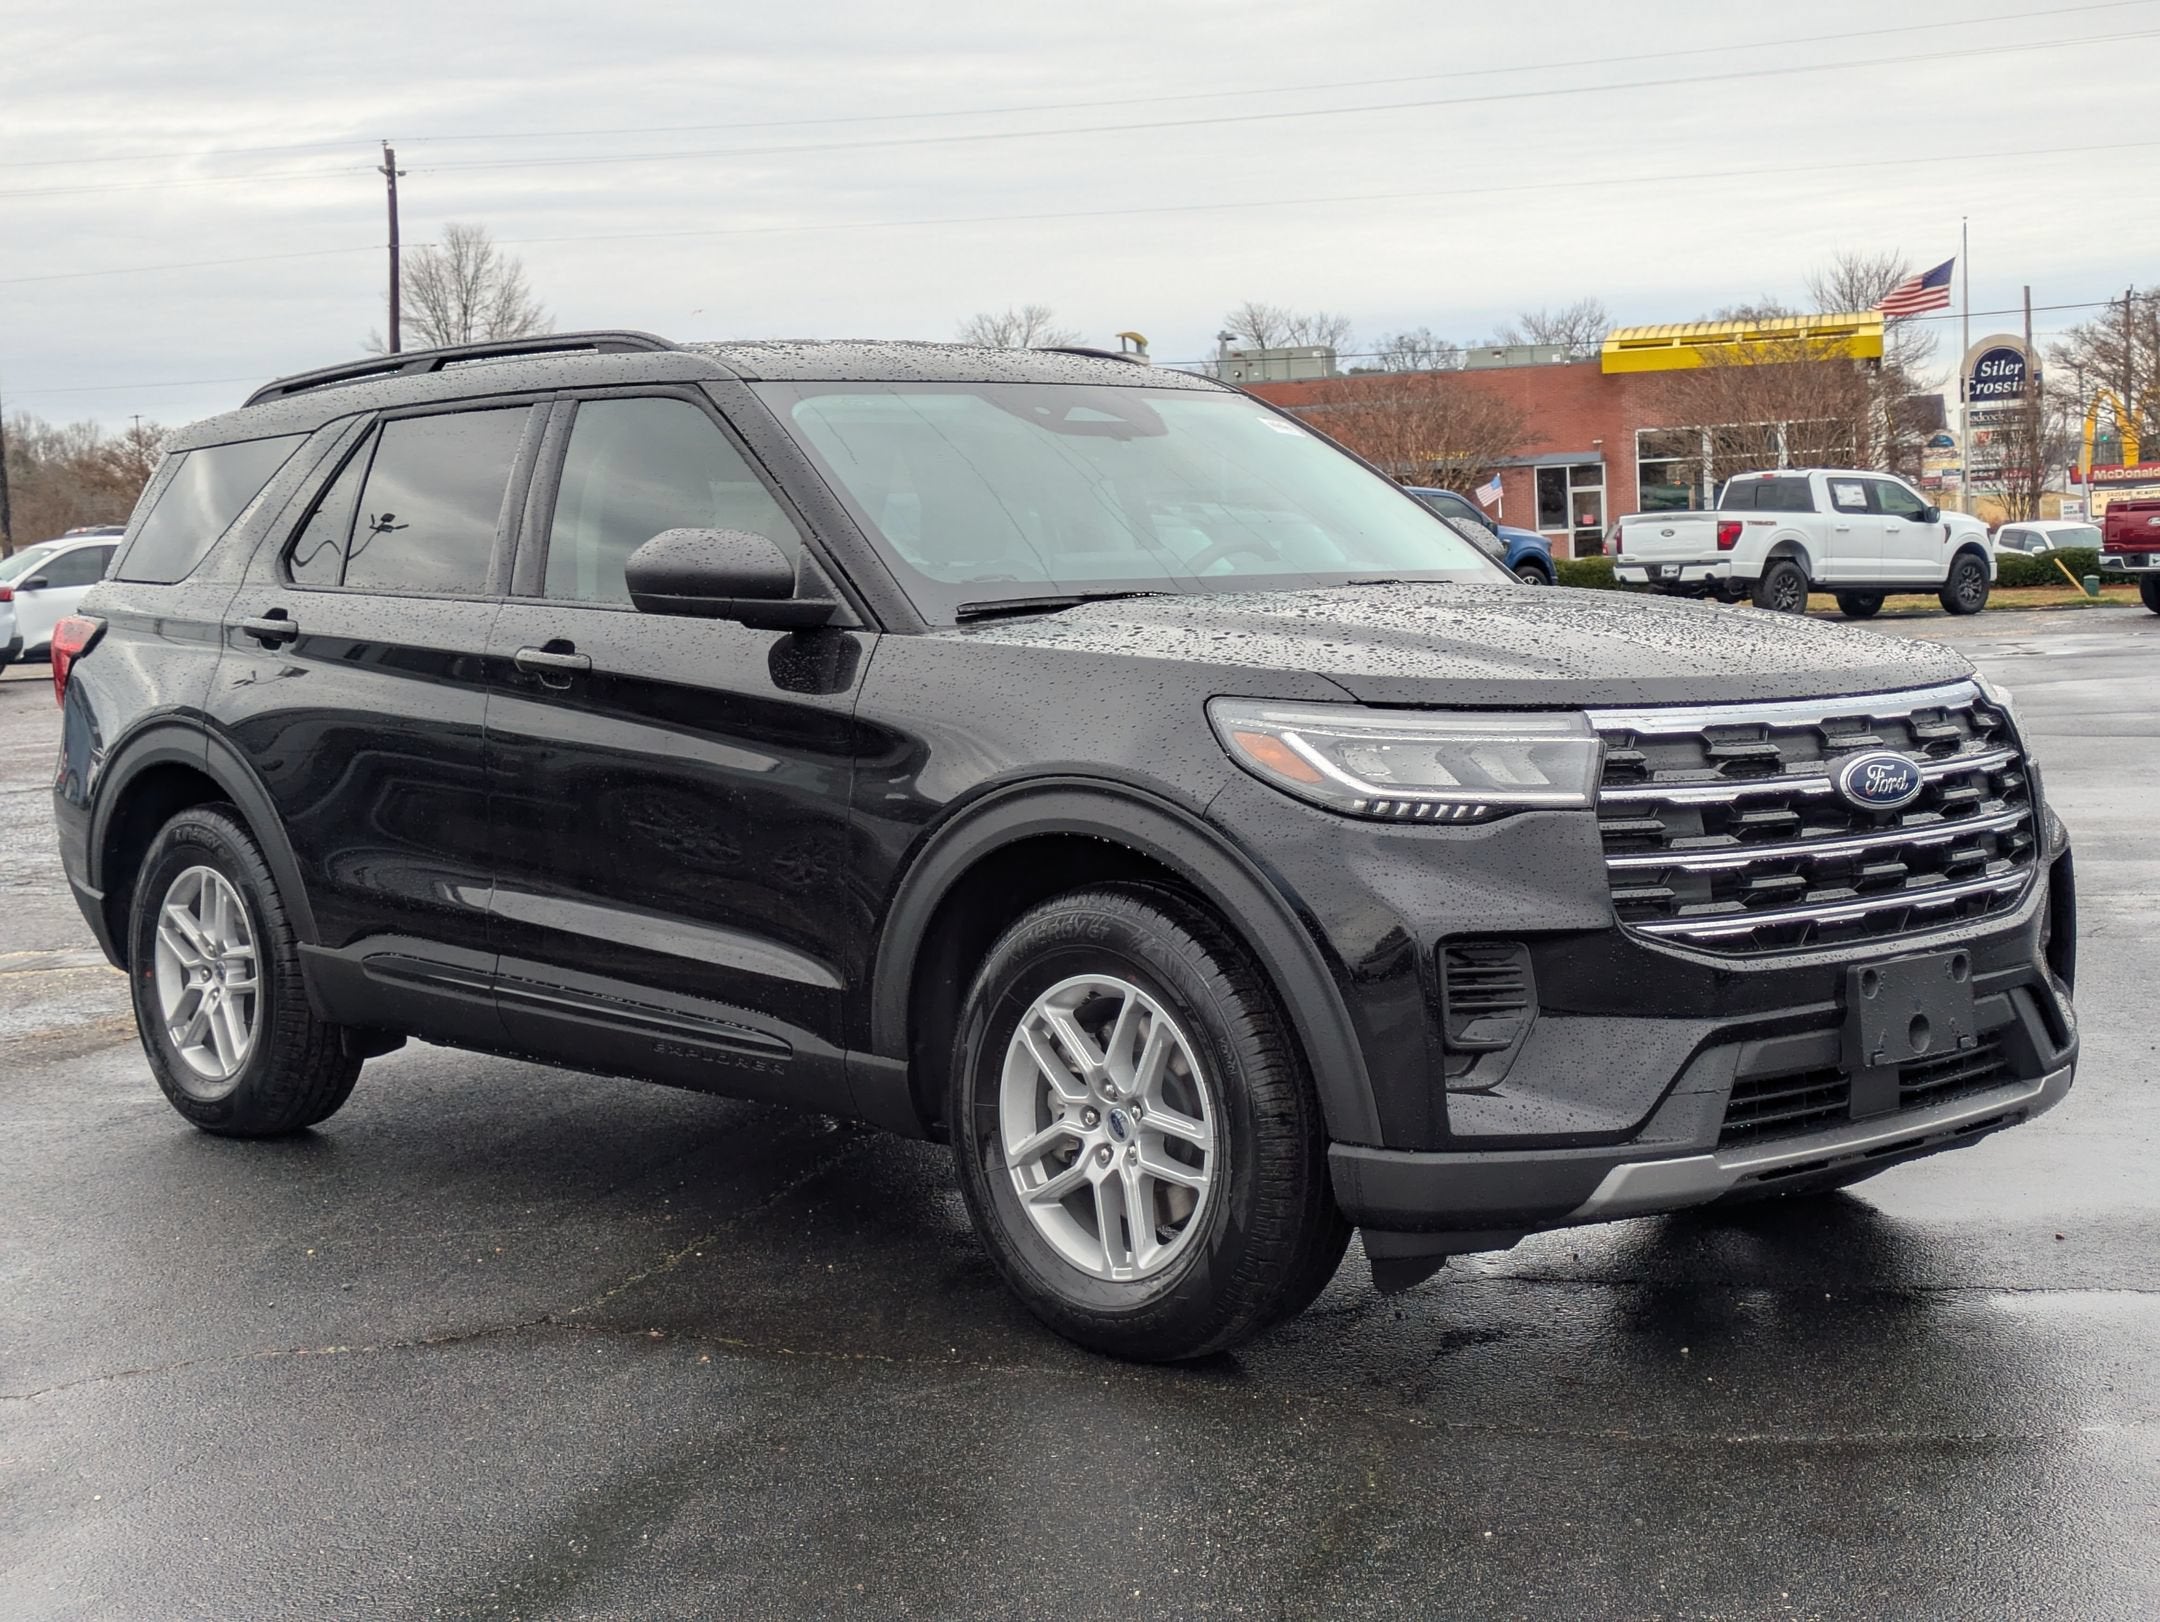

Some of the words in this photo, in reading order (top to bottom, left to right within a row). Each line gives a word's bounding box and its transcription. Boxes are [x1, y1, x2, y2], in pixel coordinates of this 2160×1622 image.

[1980, 360, 2023, 377] Siler
[1865, 764, 1909, 796] Ford
[651, 1040, 786, 1076] EXPLORER
